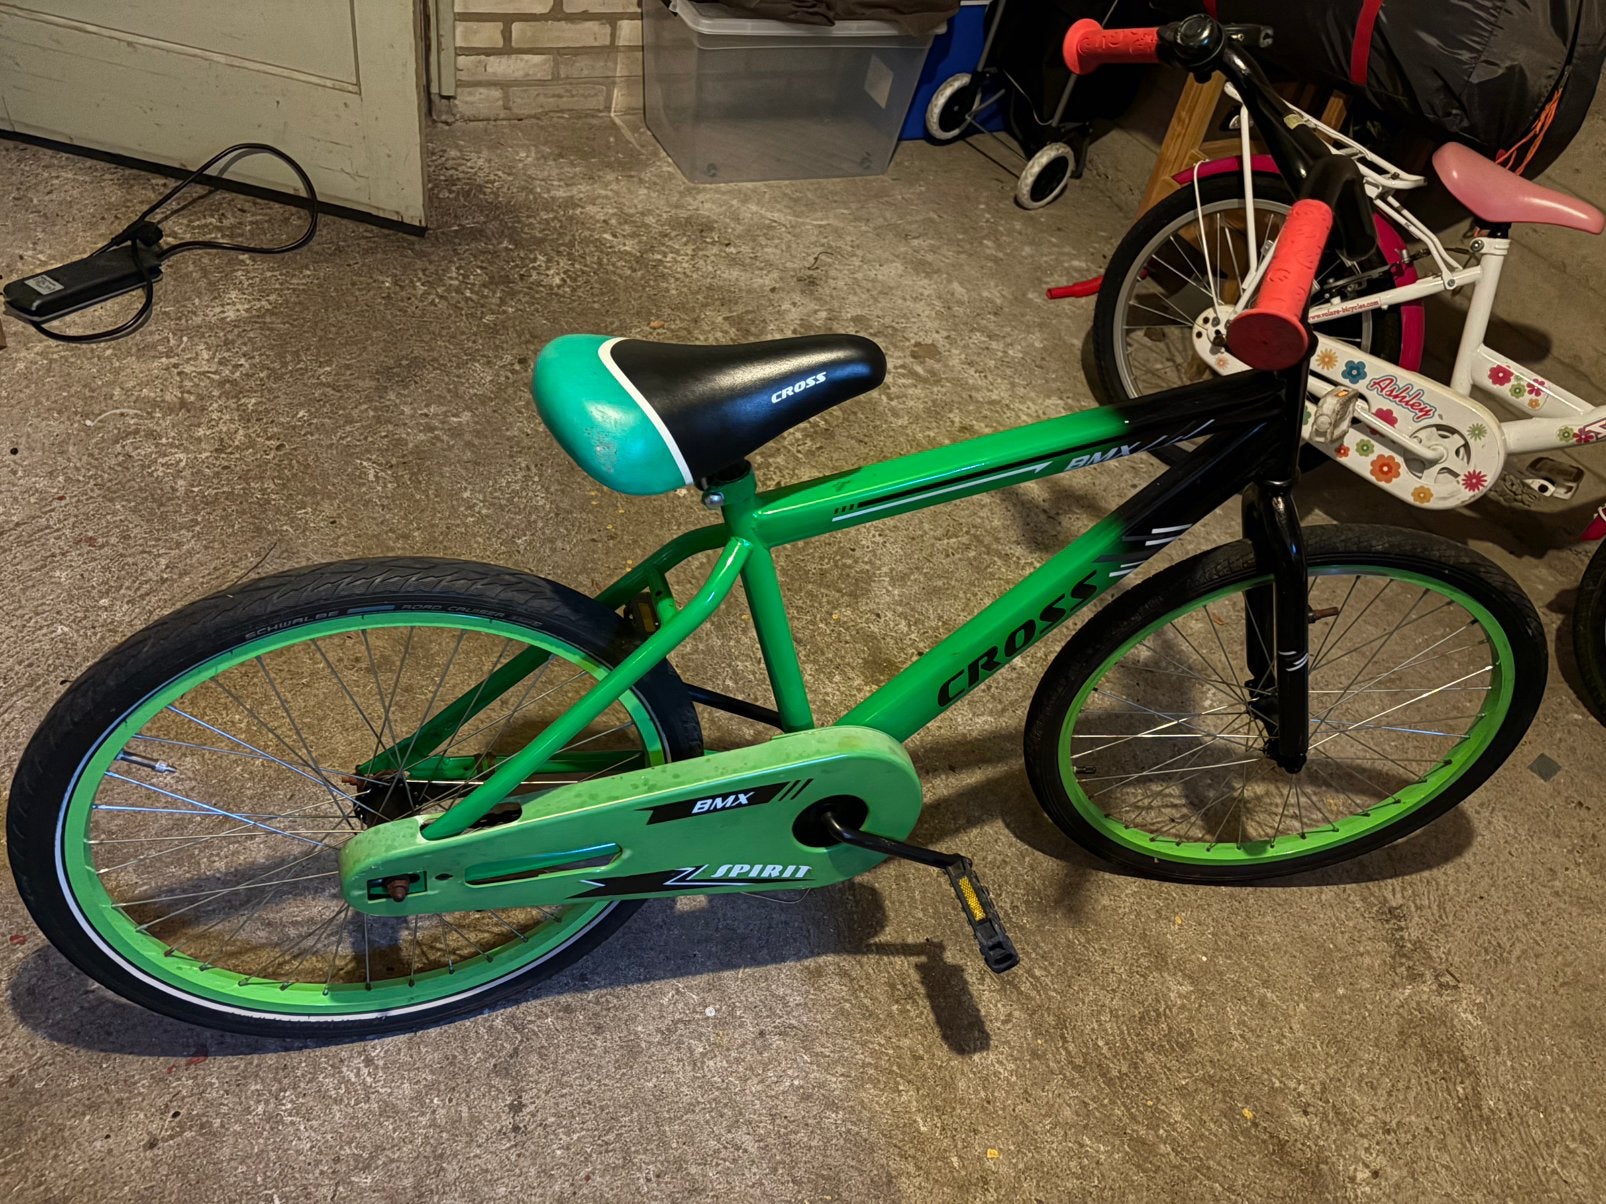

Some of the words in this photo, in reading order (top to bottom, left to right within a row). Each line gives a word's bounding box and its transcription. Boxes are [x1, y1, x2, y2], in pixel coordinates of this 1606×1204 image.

[771, 372, 827, 404] CROSS
[1368, 375, 1437, 422] Ashley
[1064, 441, 1141, 471] BMX
[244, 610, 340, 640] SCHWALBE
[447, 605, 505, 617] CRUISER
[937, 569, 1098, 708] CROSS
[691, 792, 755, 815] BMX
[711, 864, 813, 878] SPIRIT
